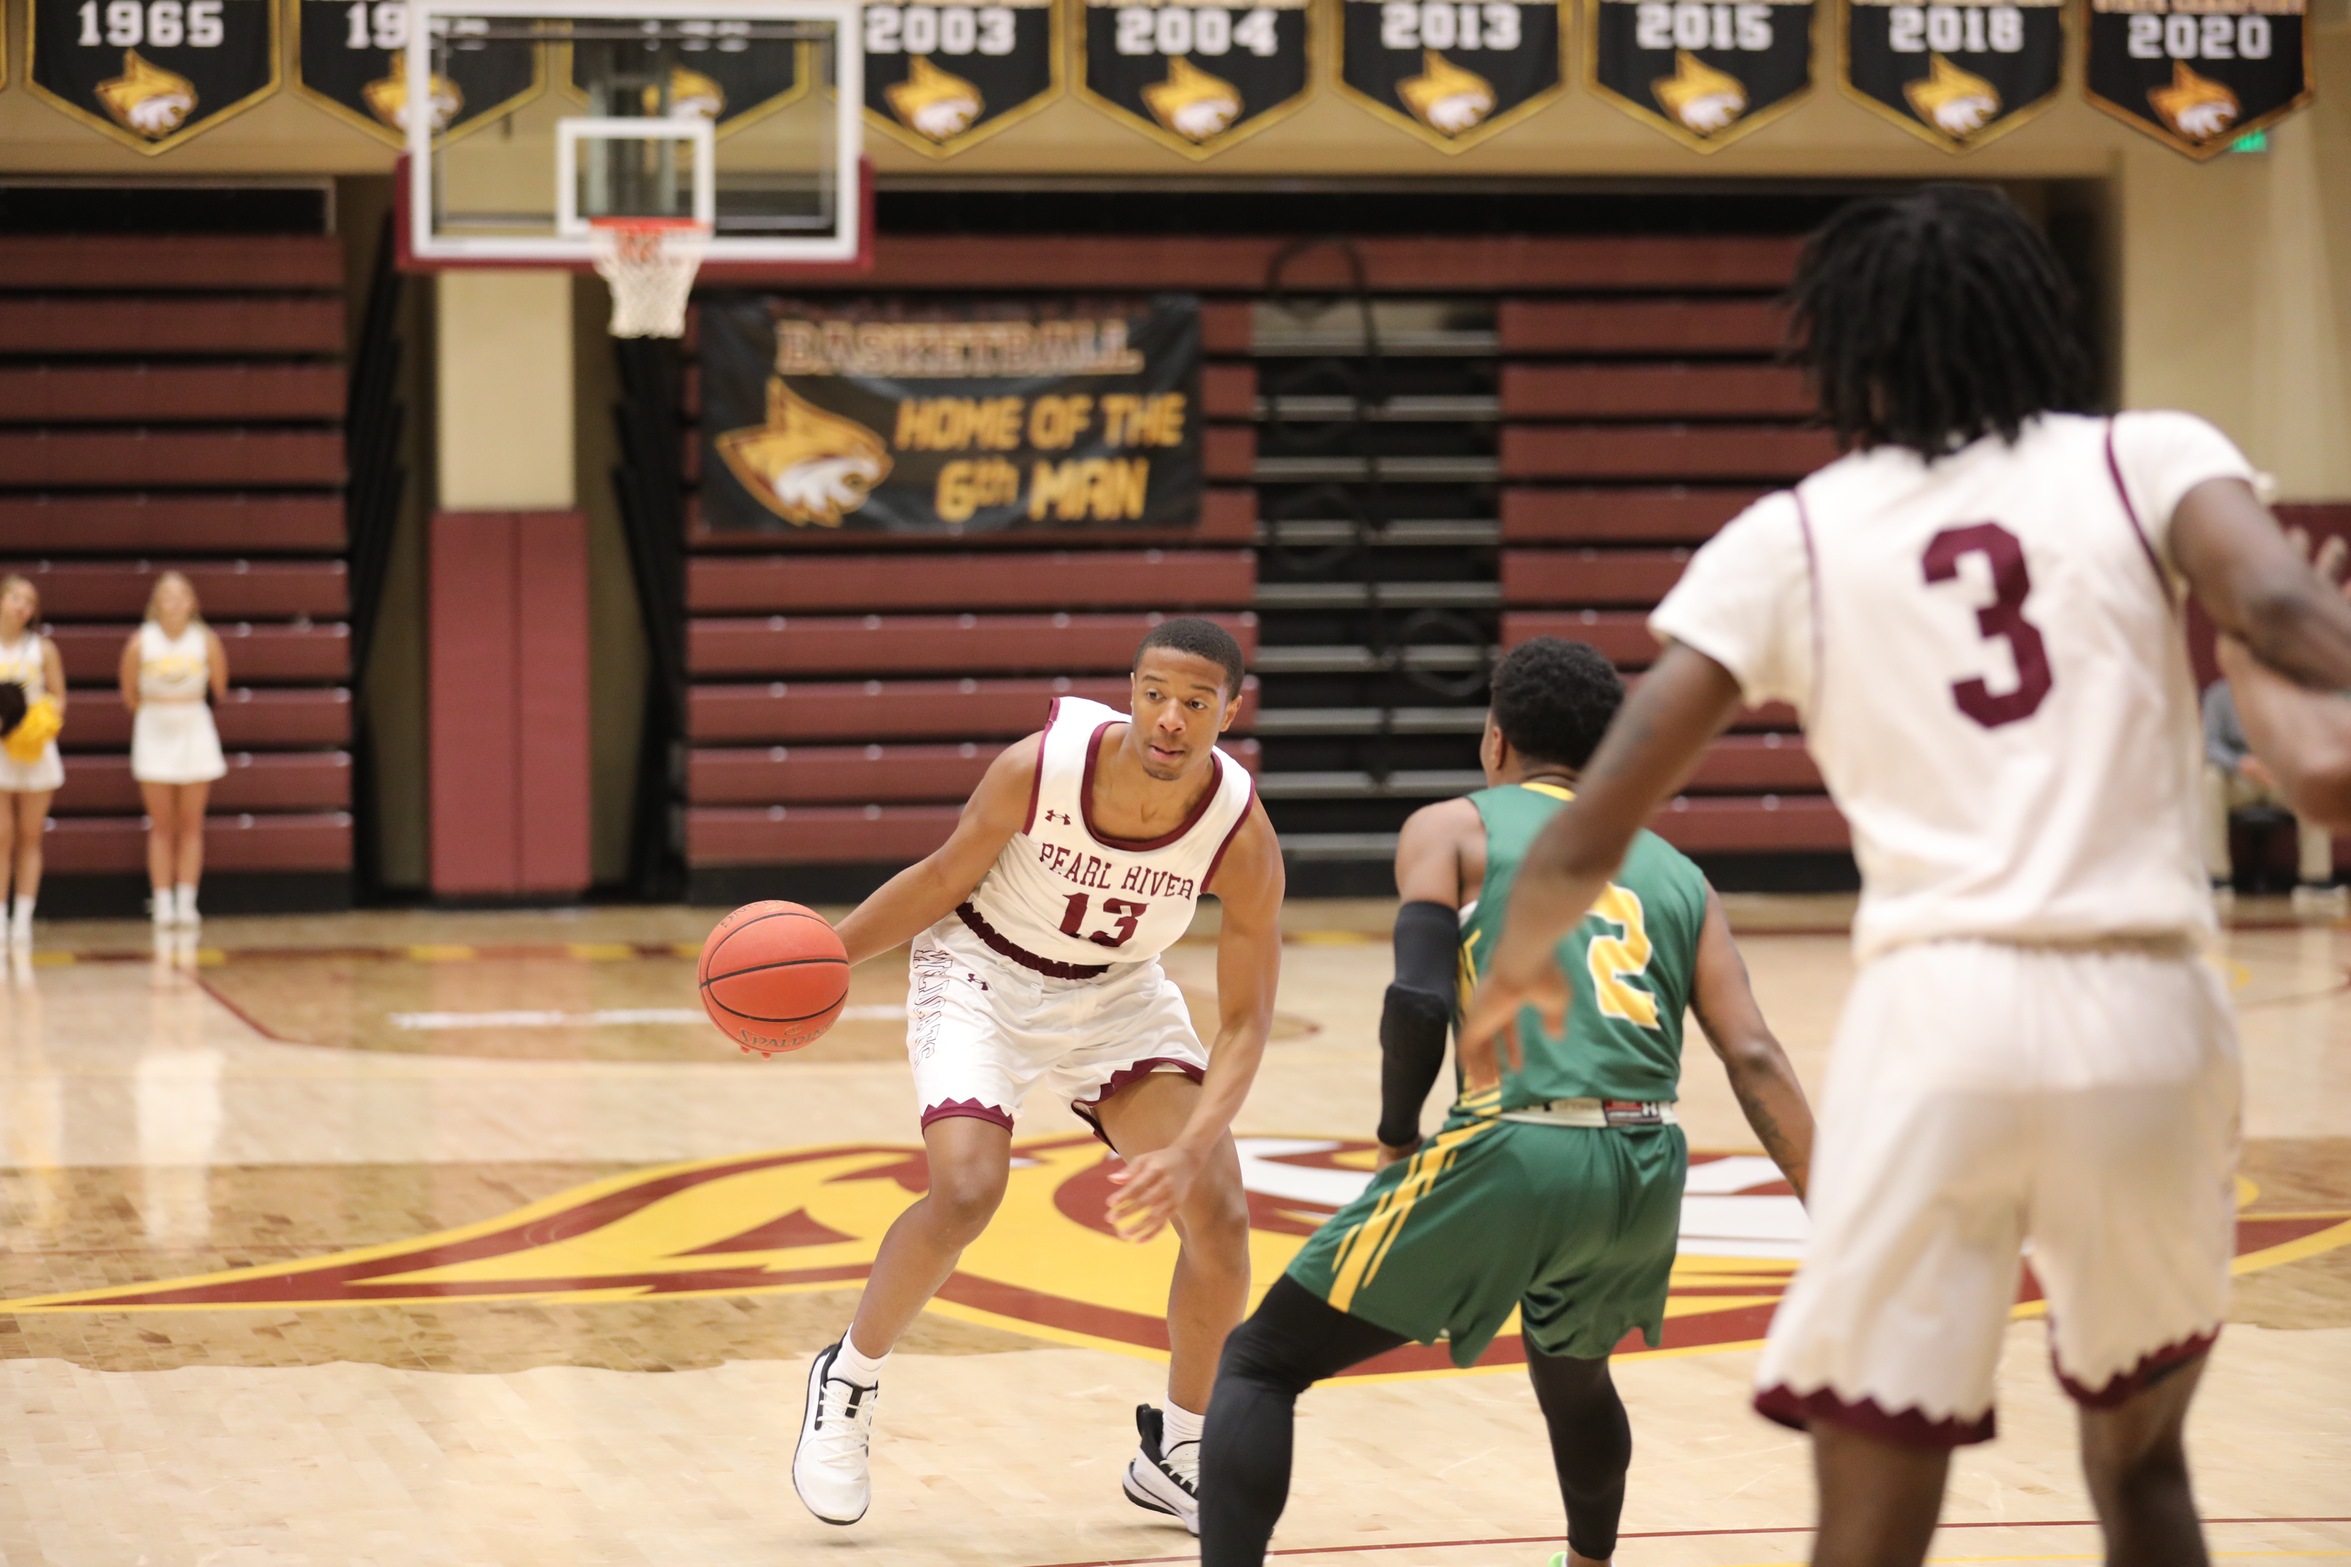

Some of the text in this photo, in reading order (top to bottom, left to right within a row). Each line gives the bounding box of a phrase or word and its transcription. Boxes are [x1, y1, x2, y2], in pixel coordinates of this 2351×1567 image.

[77, 0, 225, 47] 1965
[866, 7, 1015, 54] 2003
[1116, 7, 1278, 55] 2004
[1382, 2, 1521, 50] 2013
[1636, 3, 1773, 51] 2015
[1889, 5, 2024, 53] 2018
[2127, 14, 2272, 60] 2020
[775, 319, 1146, 377] BASKETBALL
[895, 392, 1186, 451] HOME OF THE
[1028, 457, 1150, 522] MAN
[1922, 522, 2054, 730] 3
[1039, 842, 1194, 900] PEARL RIVER
[1059, 892, 1150, 948] 13
[1586, 880, 1662, 1031] 2
